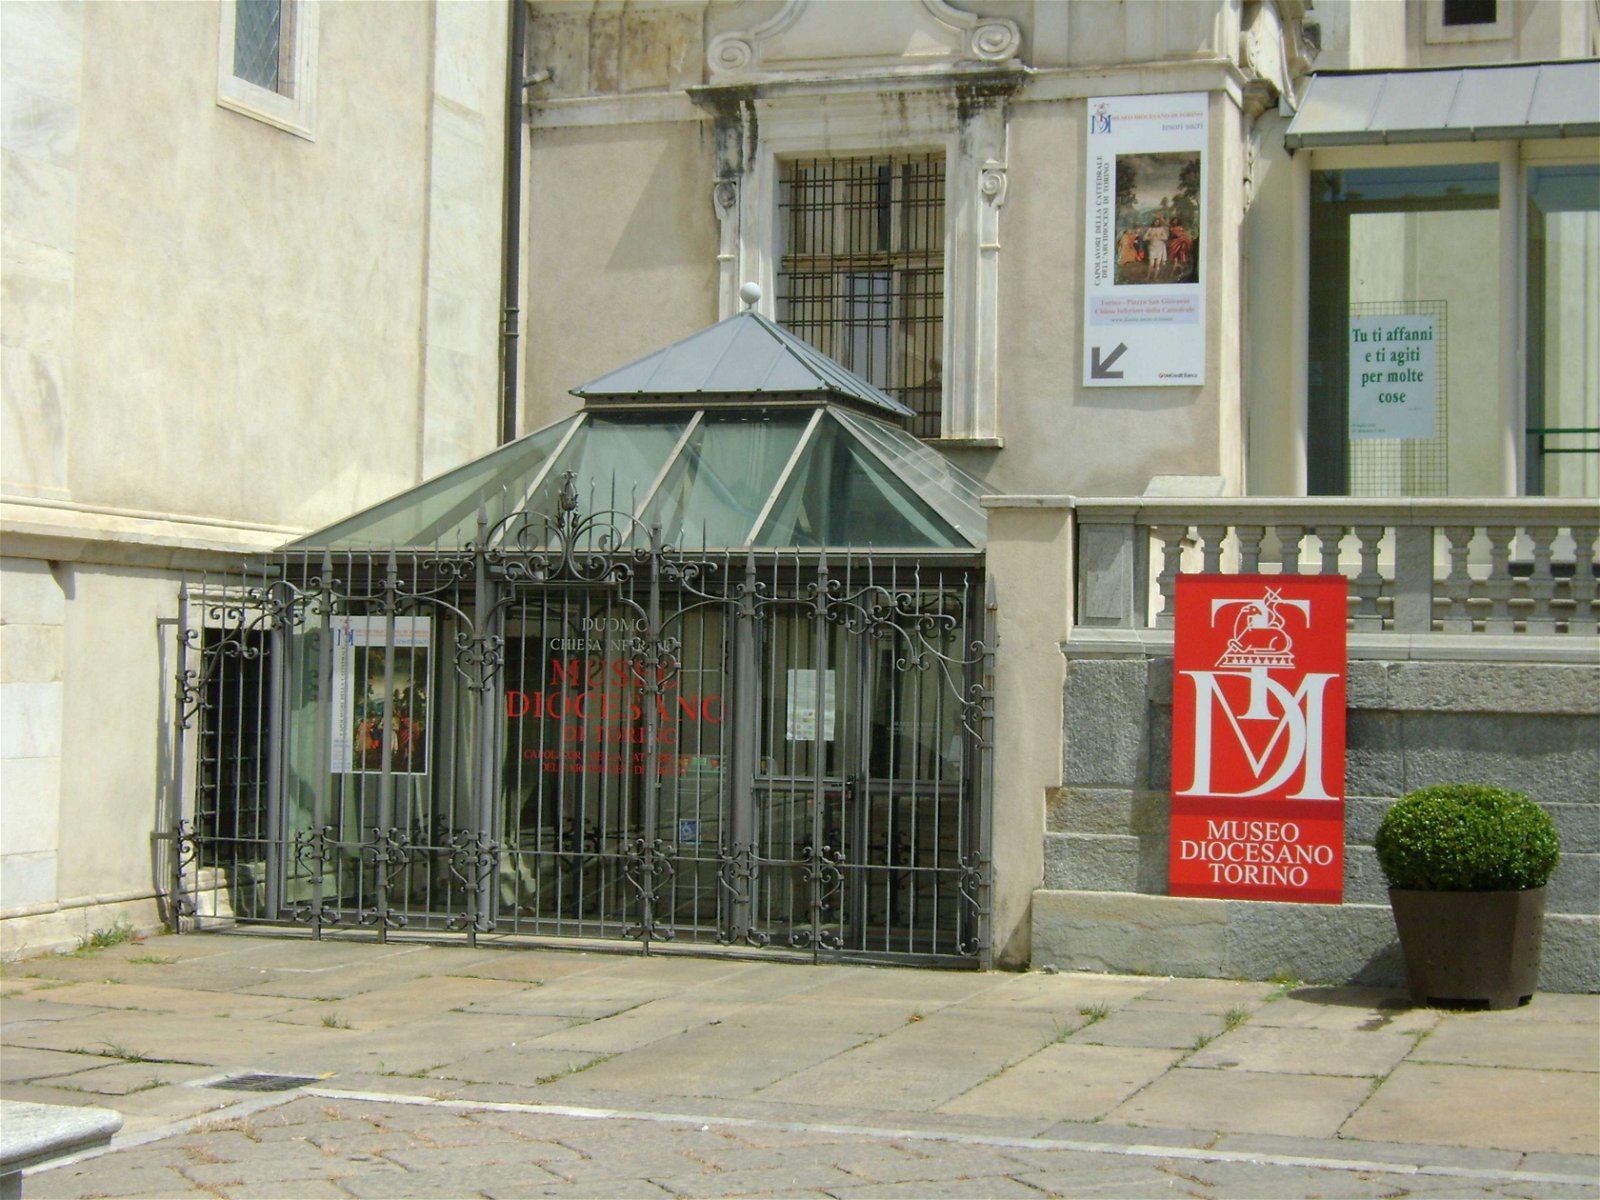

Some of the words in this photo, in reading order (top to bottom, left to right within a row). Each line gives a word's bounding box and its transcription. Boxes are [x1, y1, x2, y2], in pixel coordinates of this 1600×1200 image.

[1103, 195, 1109, 204] DI
[1352, 328, 1368, 342] Tu
[1372, 327, 1382, 342] ti
[1386, 325, 1433, 341] affanni
[1365, 351, 1372, 362] e
[1376, 347, 1385, 362] ti
[1390, 346, 1420, 366] agiti
[1361, 371, 1383, 387] per
[1388, 368, 1424, 382] molte
[1378, 392, 1406, 403] cose
[582, 617, 649, 632] DUOMO
[550, 638, 601, 651] CHIESA
[506, 691, 729, 723] DIOCESANO
[1207, 820, 1300, 843] MUSEO
[1180, 840, 1334, 866] DIOCESANO
[1208, 863, 1309, 887] TORINO
